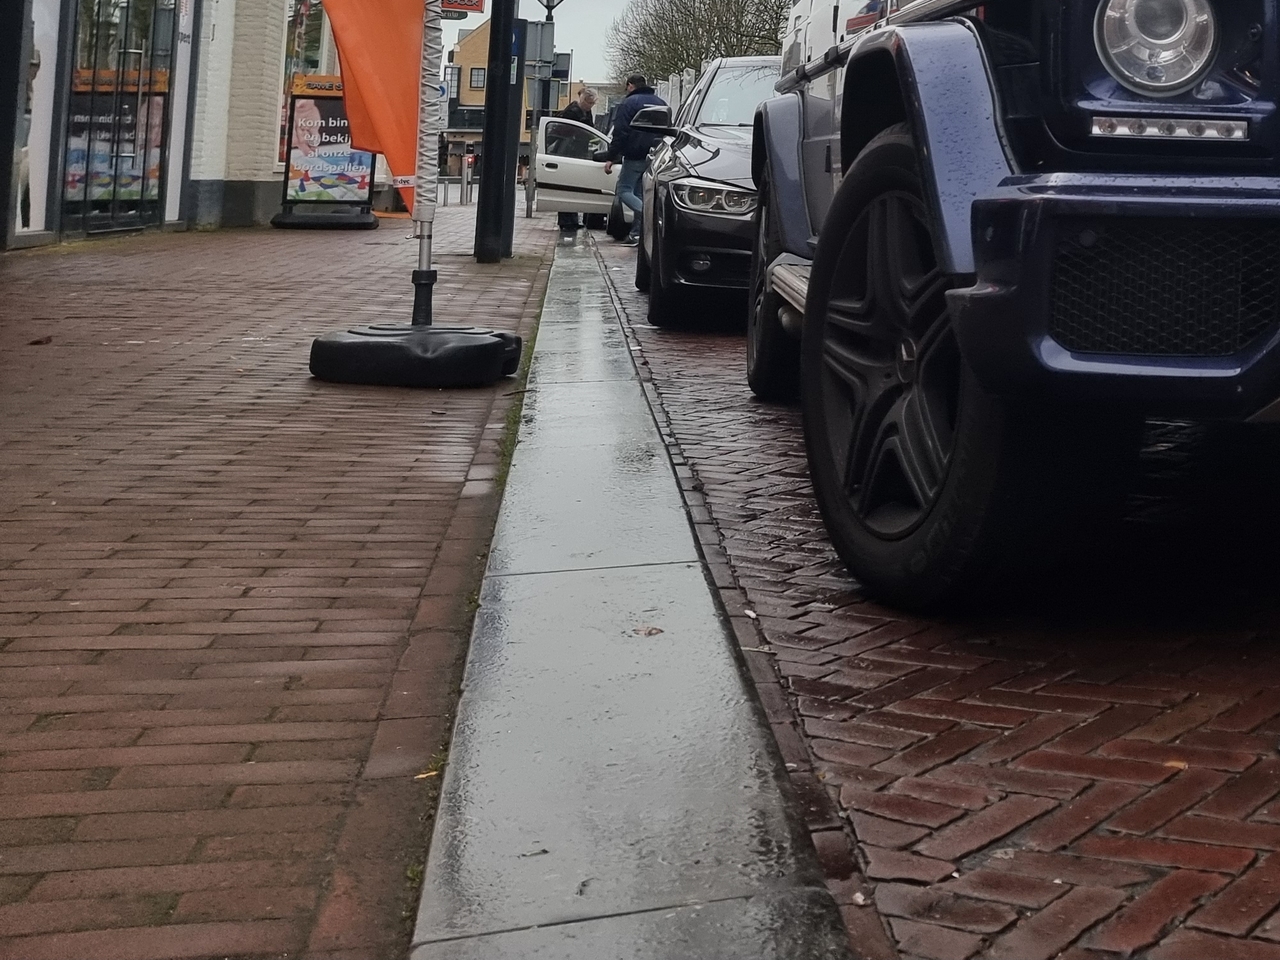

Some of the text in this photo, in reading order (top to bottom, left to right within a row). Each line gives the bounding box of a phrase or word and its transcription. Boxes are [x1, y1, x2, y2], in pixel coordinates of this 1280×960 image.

[298, 117, 348, 127] Kom bin
[321, 149, 351, 158] onze
[294, 163, 367, 173] bordspellen
